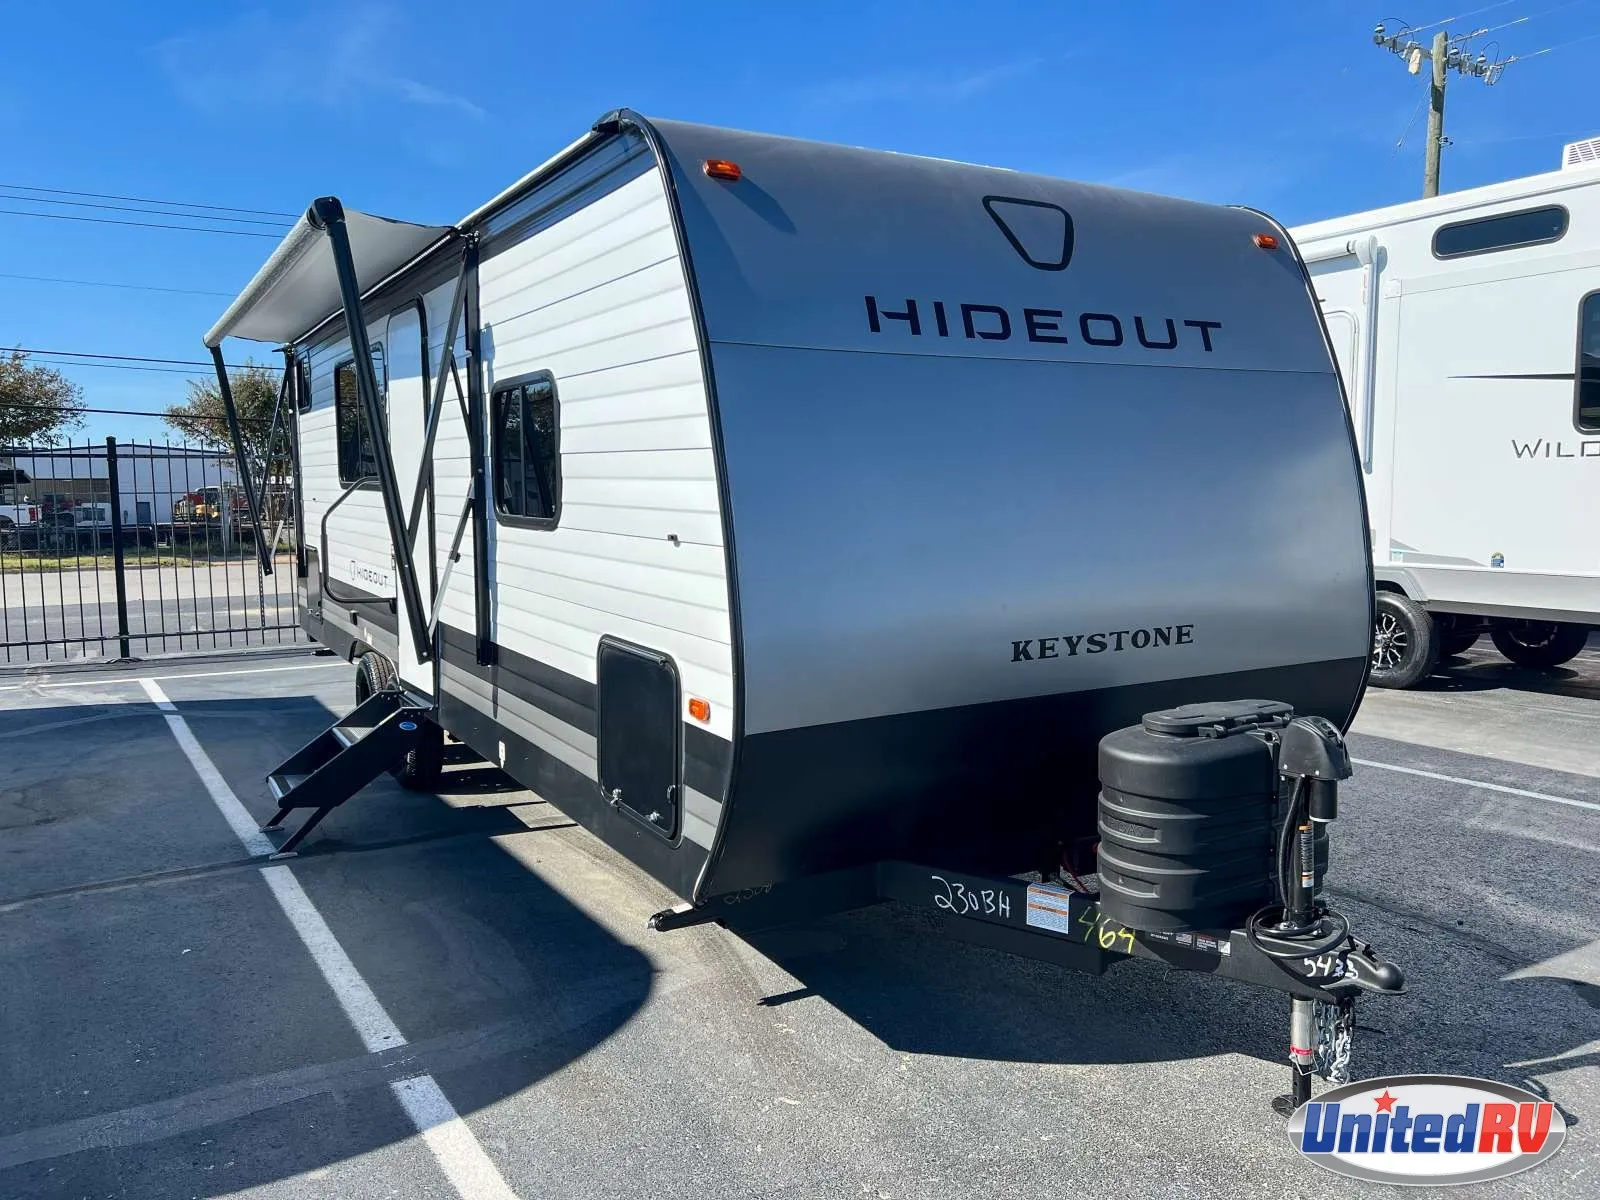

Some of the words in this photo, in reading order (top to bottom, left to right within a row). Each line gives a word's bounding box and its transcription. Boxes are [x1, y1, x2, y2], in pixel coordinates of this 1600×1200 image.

[864, 295, 1222, 352] HIDEOUT
[356, 565, 388, 588] HIDEOUT
[1010, 624, 1195, 663] KEYSTONE
[931, 875, 1010, 918] 230BH
